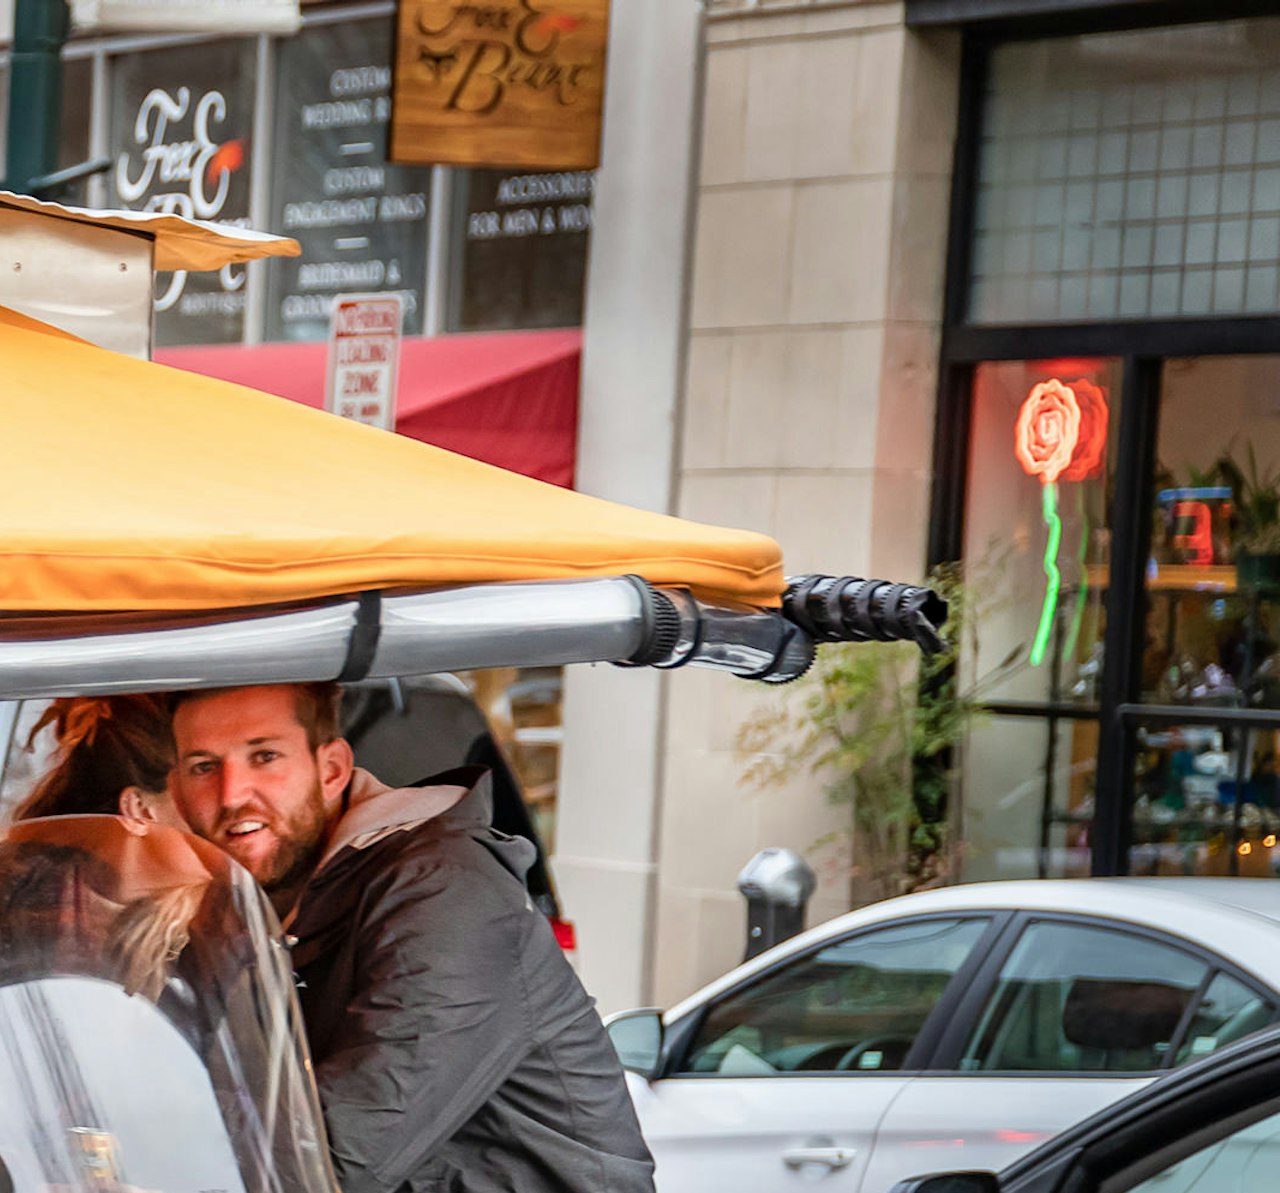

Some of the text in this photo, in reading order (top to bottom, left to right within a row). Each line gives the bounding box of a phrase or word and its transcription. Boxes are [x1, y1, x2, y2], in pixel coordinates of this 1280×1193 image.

[329, 66, 391, 96] CUSTOM
[301, 98, 372, 129] WEDDING
[117, 86, 196, 201] Fox
[324, 166, 385, 195] CUSTOM
[283, 192, 426, 228] ENGAGEMENT RINGS
[468, 211, 500, 237] FOR
[502, 208, 539, 236] MEN
[541, 207, 556, 233] &
[298, 260, 385, 290] BRIDESMAID
[338, 341, 389, 365] LOADING
[343, 370, 382, 395] ZONE
